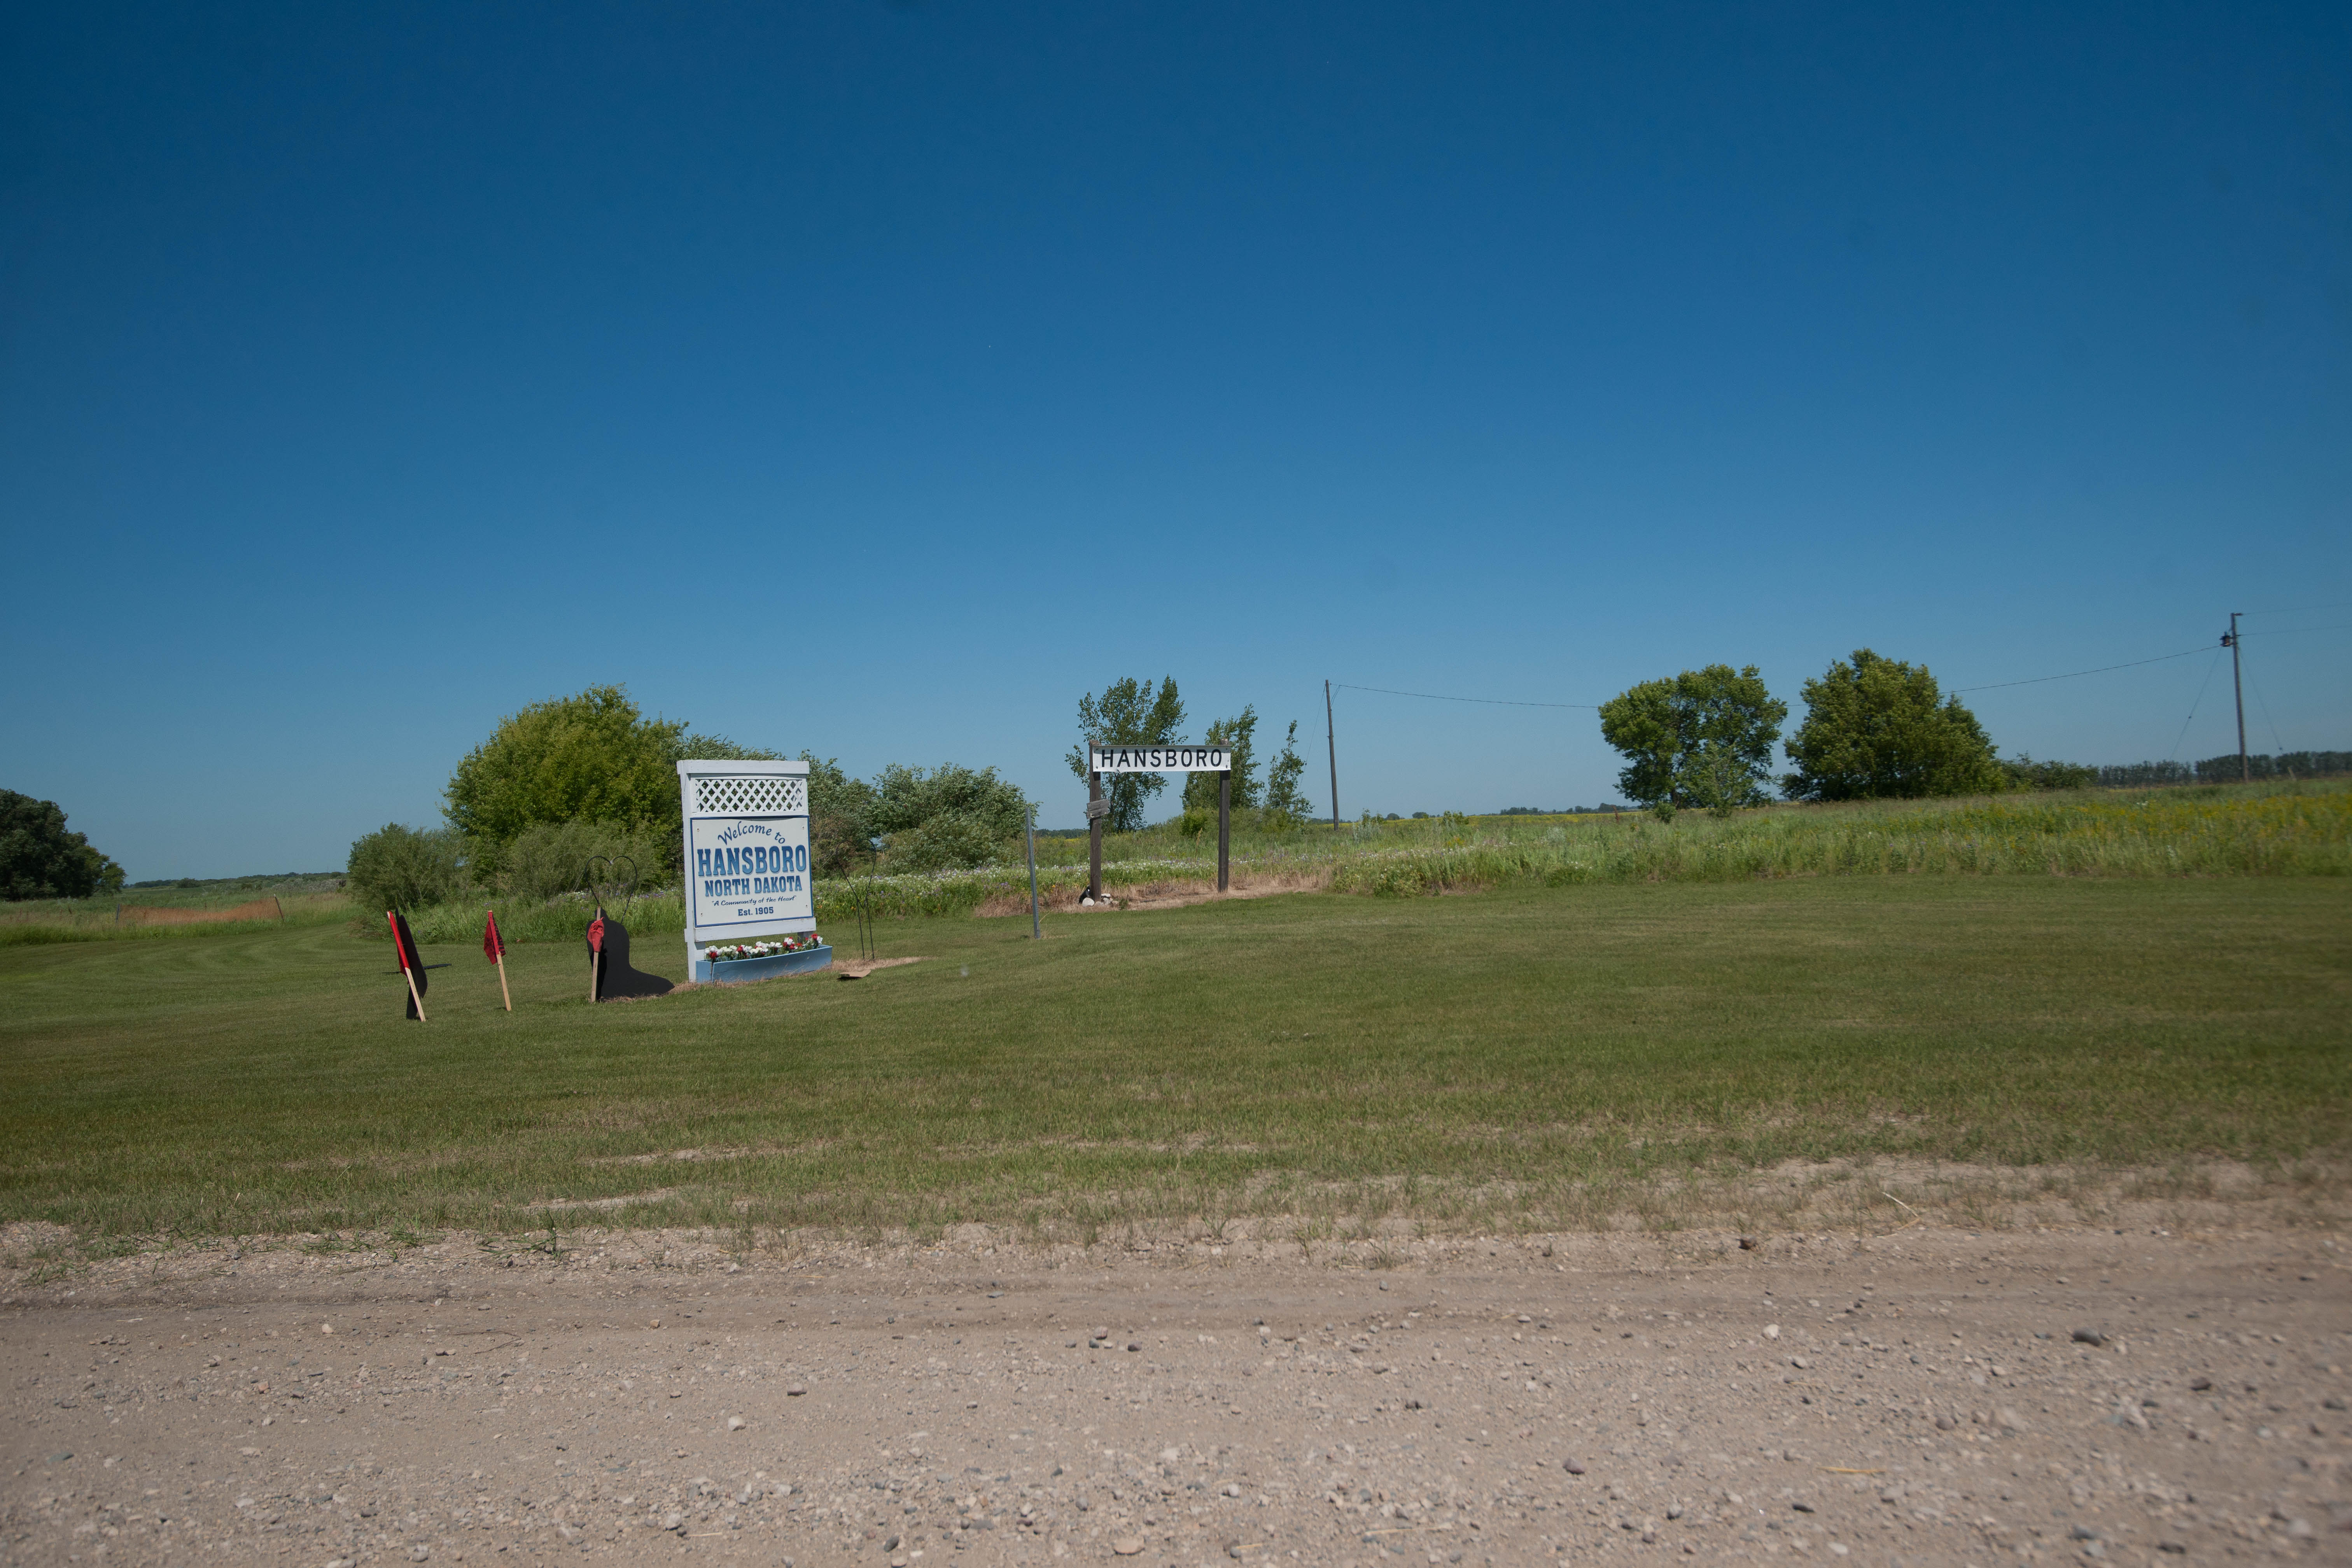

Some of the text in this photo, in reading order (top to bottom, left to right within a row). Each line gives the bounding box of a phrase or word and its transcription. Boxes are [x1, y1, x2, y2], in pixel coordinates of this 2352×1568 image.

[1101, 749, 1222, 767] HANSBORO
[718, 821, 786, 845] Welcome to
[697, 845, 807, 876] HANSBORO
[705, 875, 802, 896] NORTH DAKOTA
[755, 906, 774, 915] 1905
